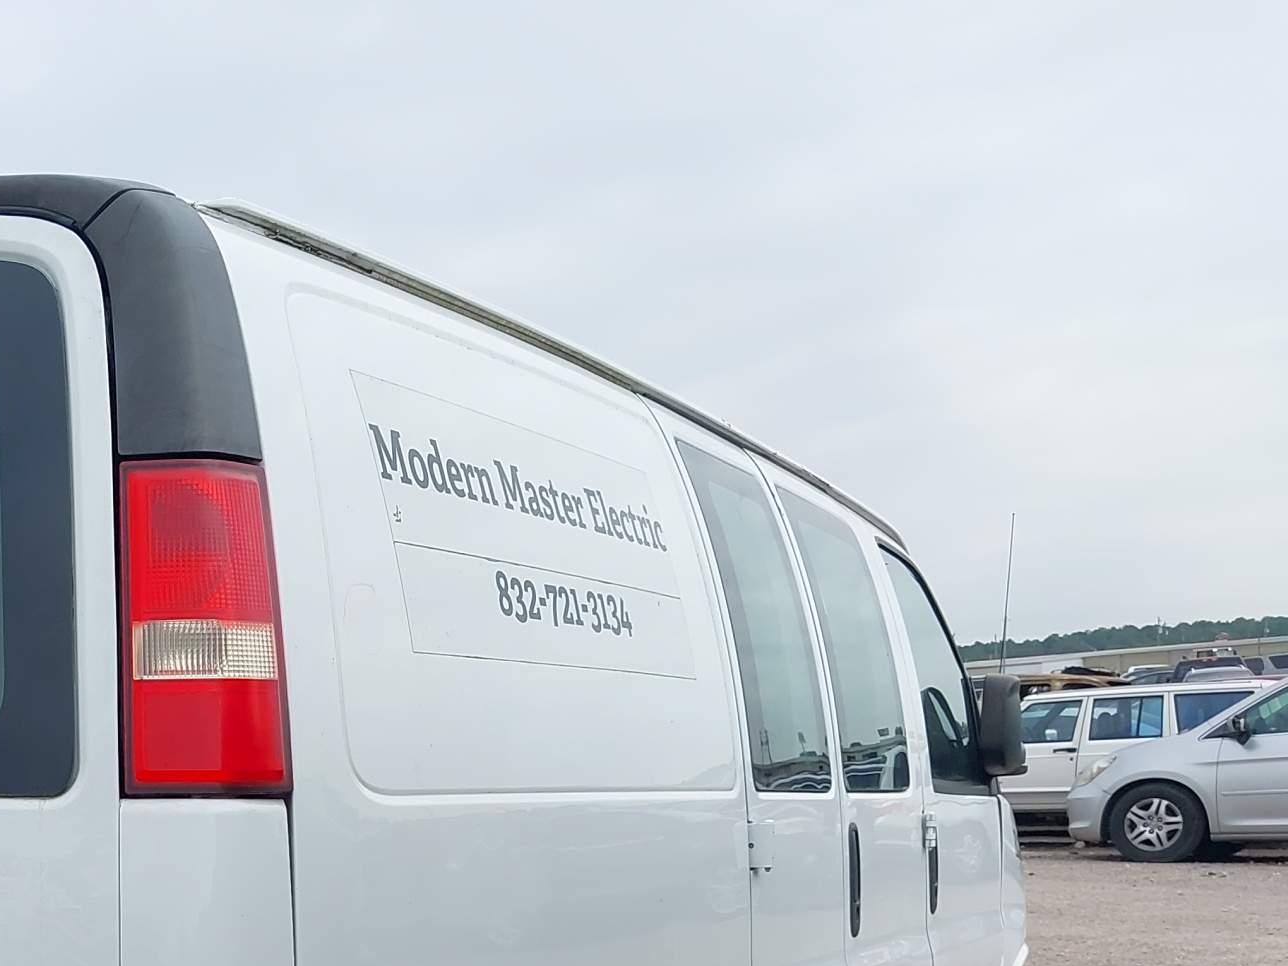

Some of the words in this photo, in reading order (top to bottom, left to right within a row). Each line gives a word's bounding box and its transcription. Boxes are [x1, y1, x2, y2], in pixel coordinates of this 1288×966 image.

[368, 423, 499, 506] Modern
[494, 460, 587, 529] Master
[584, 487, 668, 552] Electric
[495, 570, 633, 638] 832-721-3134
